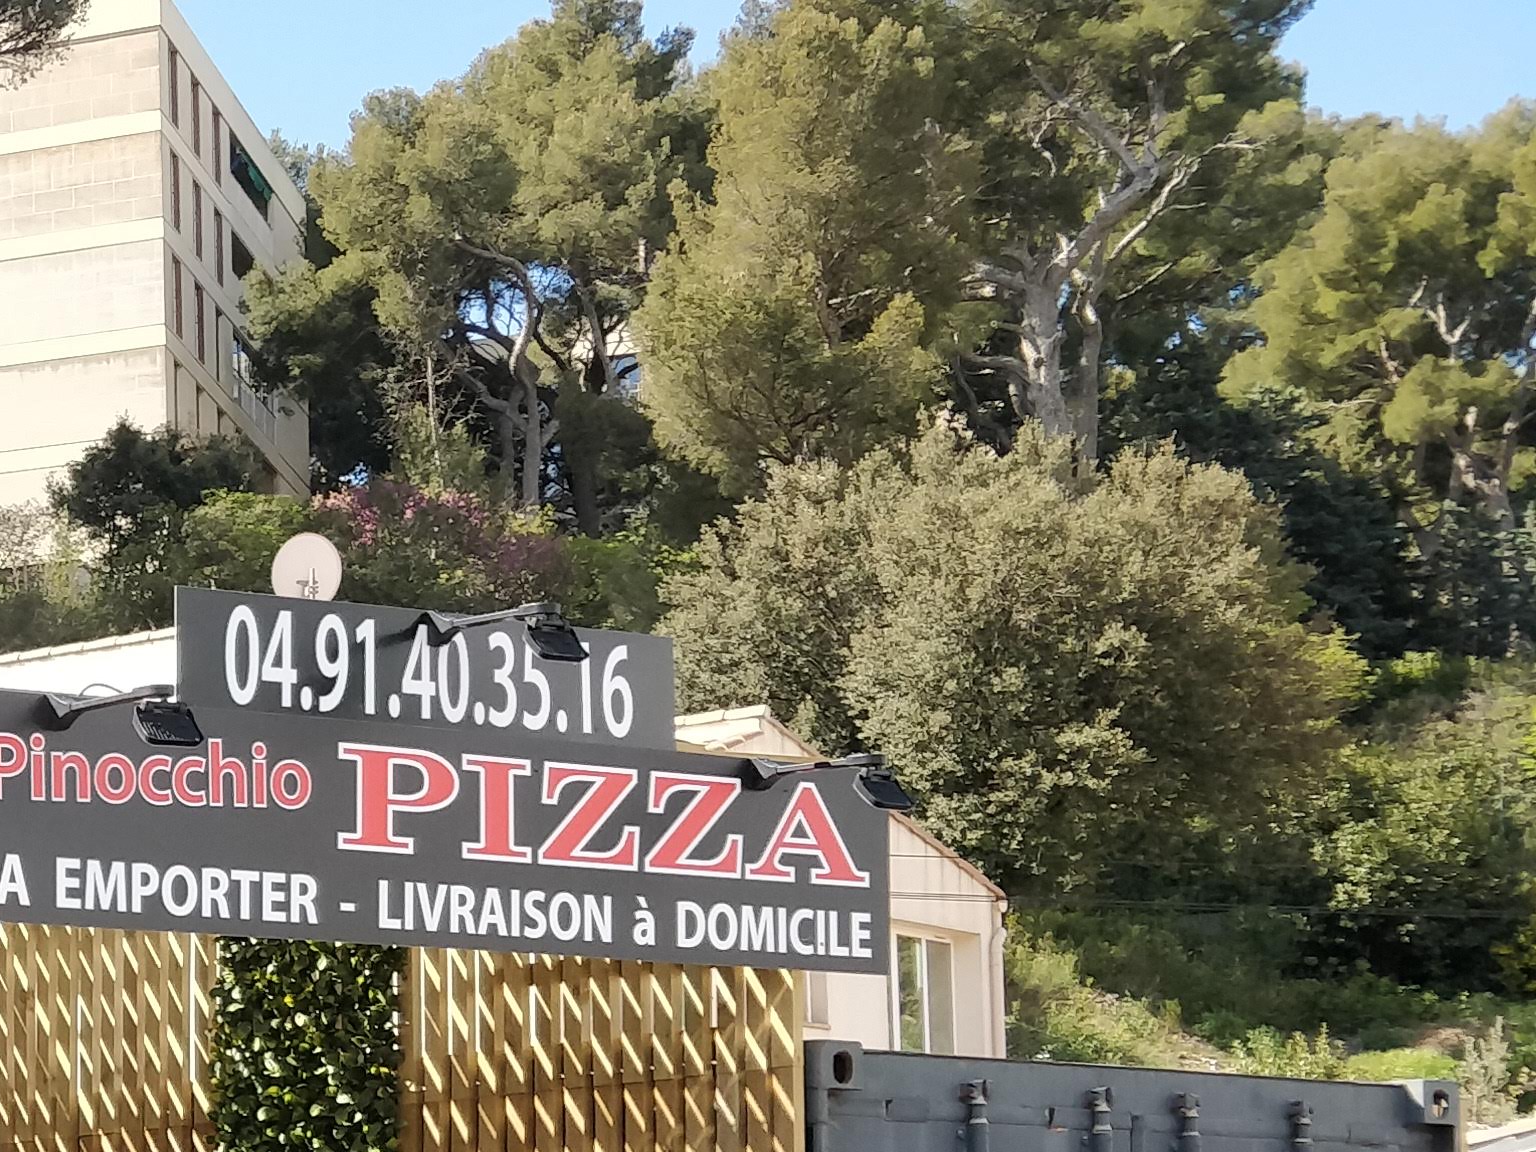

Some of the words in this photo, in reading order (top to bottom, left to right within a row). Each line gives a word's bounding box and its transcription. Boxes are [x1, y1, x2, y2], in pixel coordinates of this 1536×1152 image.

[225, 604, 634, 739] 04.91.40.35.16
[337, 741, 871, 889] PIZZA
[56, 857, 319, 925] EMPORTER
[340, 902, 355, 912] -
[378, 880, 613, 943] LIVRAISON
[632, 897, 656, 946] à
[676, 901, 873, 958] DOMICILE
